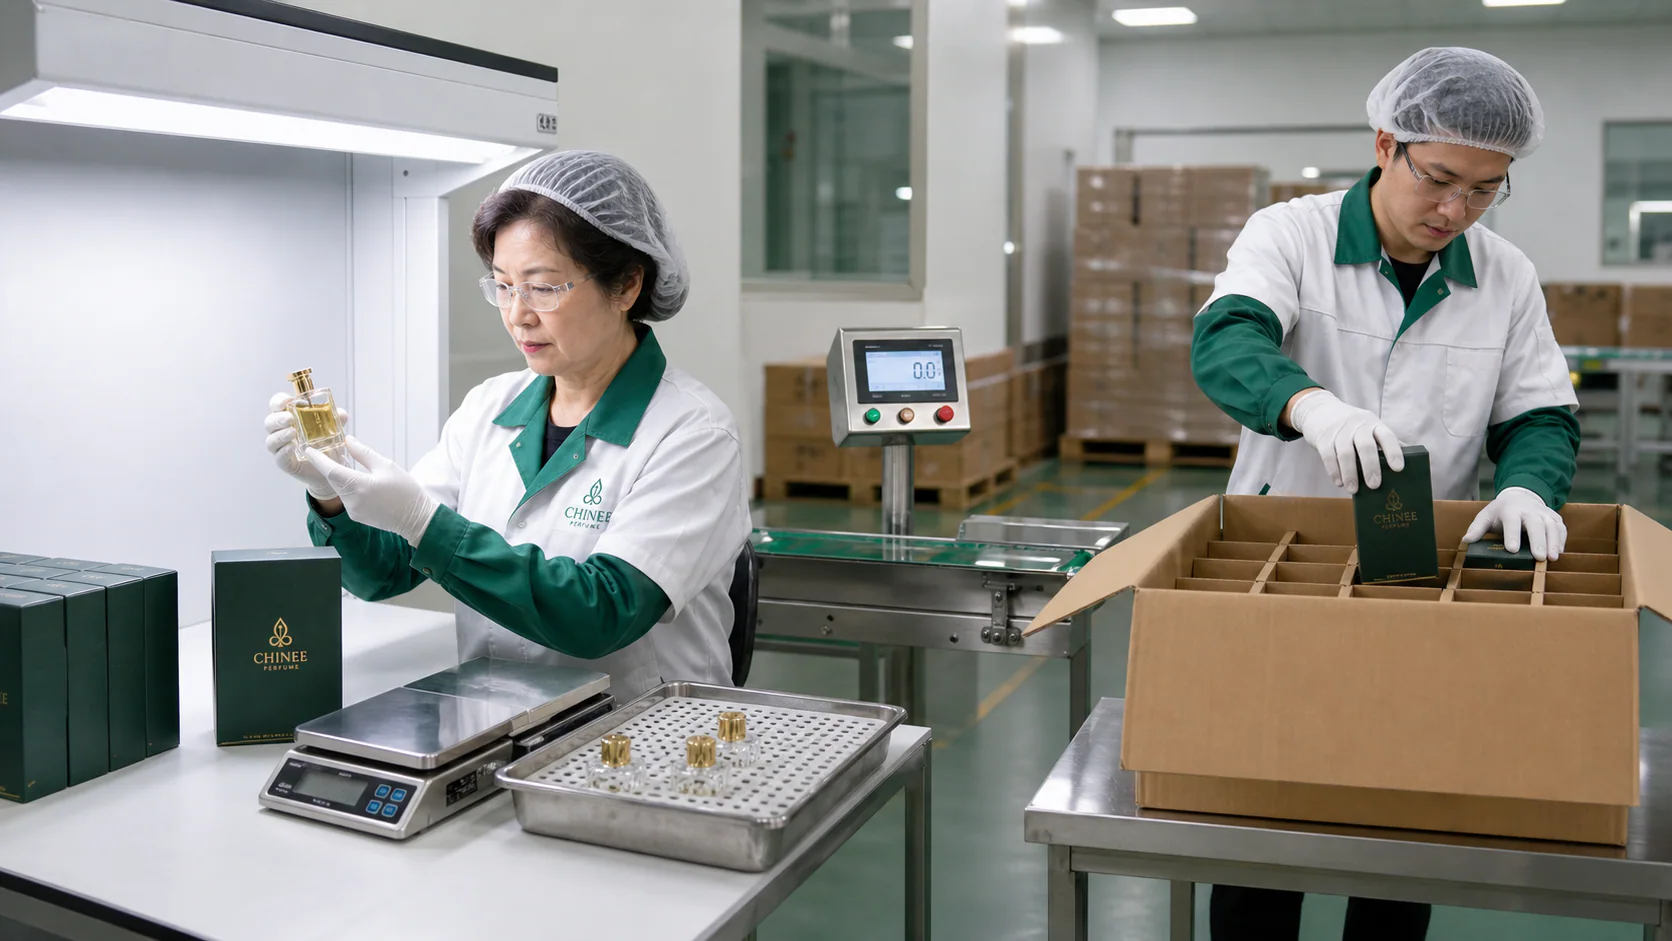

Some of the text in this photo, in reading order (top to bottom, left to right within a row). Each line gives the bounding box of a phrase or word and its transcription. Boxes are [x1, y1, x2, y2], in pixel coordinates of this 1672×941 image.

[913, 361, 936, 379] 0.0
[1373, 511, 1418, 524] CHINEE
[253, 650, 308, 665] CHINEE
